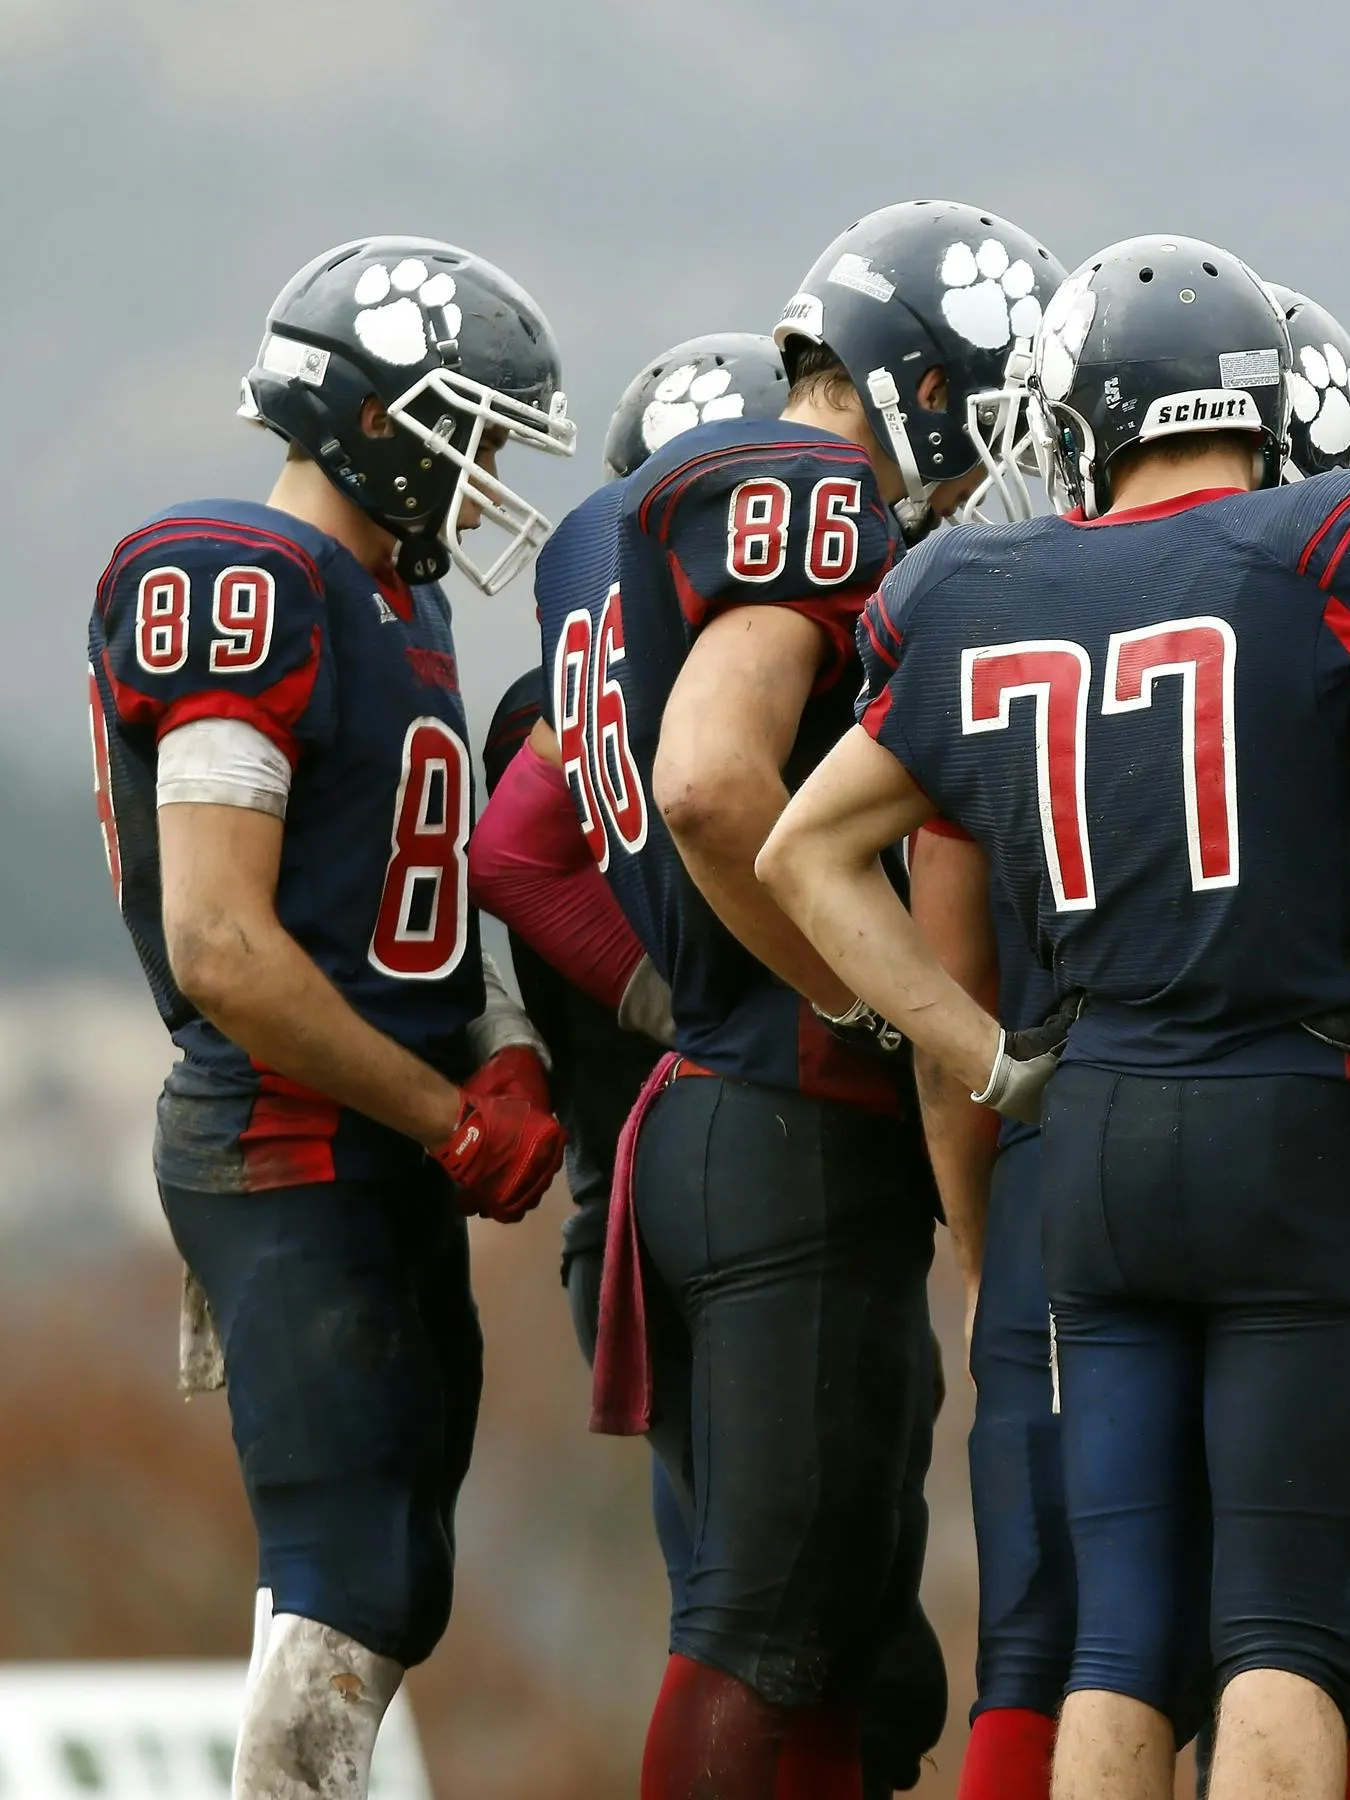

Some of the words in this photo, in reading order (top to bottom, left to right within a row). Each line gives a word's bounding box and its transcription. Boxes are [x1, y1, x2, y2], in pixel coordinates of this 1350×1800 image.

[1158, 398, 1247, 424] schutt
[135, 566, 276, 674] 89
[726, 476, 862, 585] 86
[553, 582, 649, 874] 86
[961, 615, 1241, 913] 77
[367, 715, 471, 981] 8
